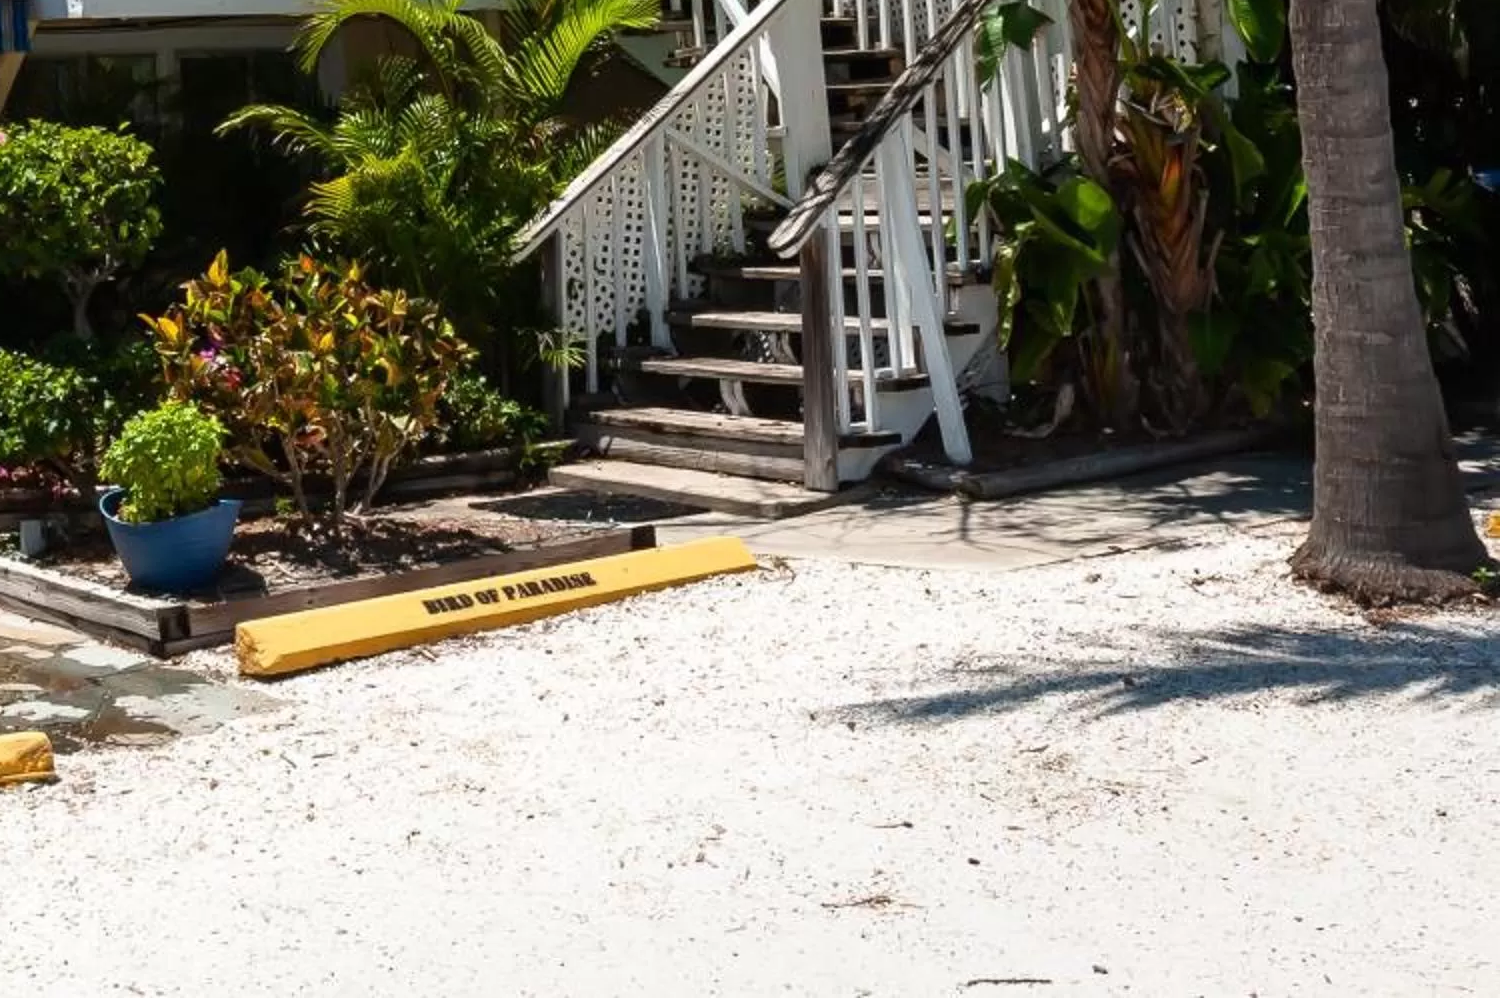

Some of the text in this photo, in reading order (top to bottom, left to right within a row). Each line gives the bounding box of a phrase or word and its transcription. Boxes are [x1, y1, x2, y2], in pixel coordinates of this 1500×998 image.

[421, 572, 597, 614] BIRD OF PARADISE
